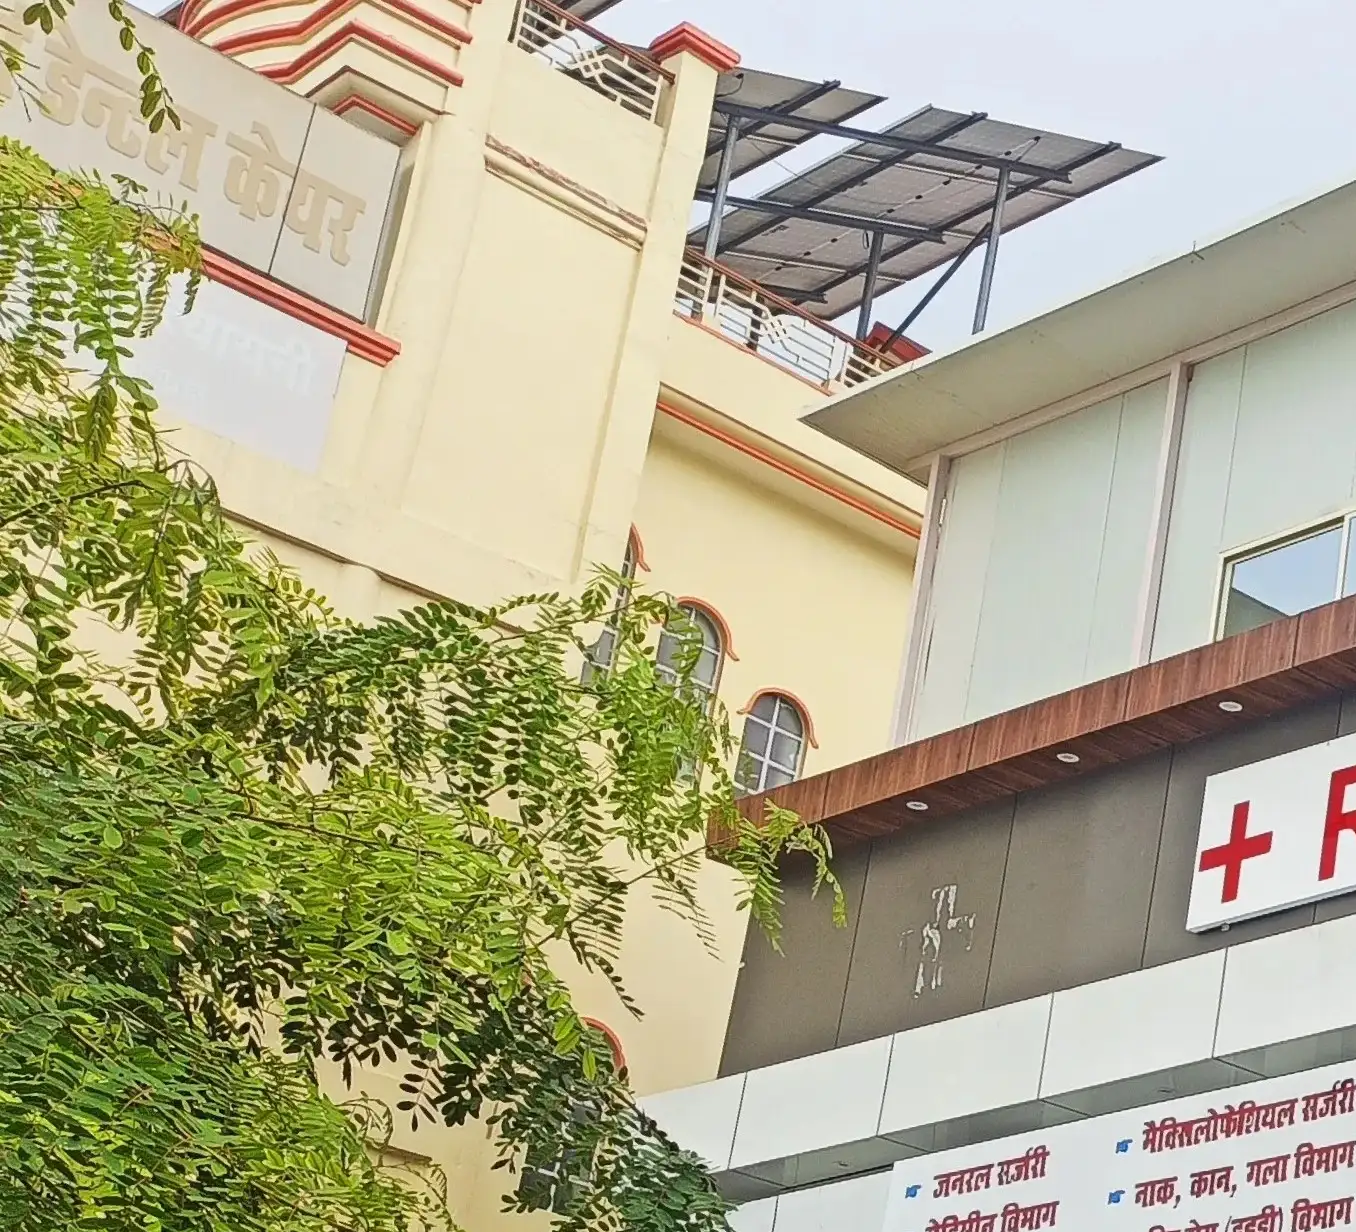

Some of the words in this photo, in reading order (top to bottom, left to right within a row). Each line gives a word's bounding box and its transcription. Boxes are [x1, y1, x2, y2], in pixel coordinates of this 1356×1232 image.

[934, 1164, 994, 1198] जनरल
[998, 1145, 1049, 1185] सर्जरी
[1135, 1177, 1182, 1209] नाक,
[1190, 1166, 1238, 1199] कान,
[1247, 1154, 1290, 1186] गला
[1294, 1141, 1356, 1178] विभाग
